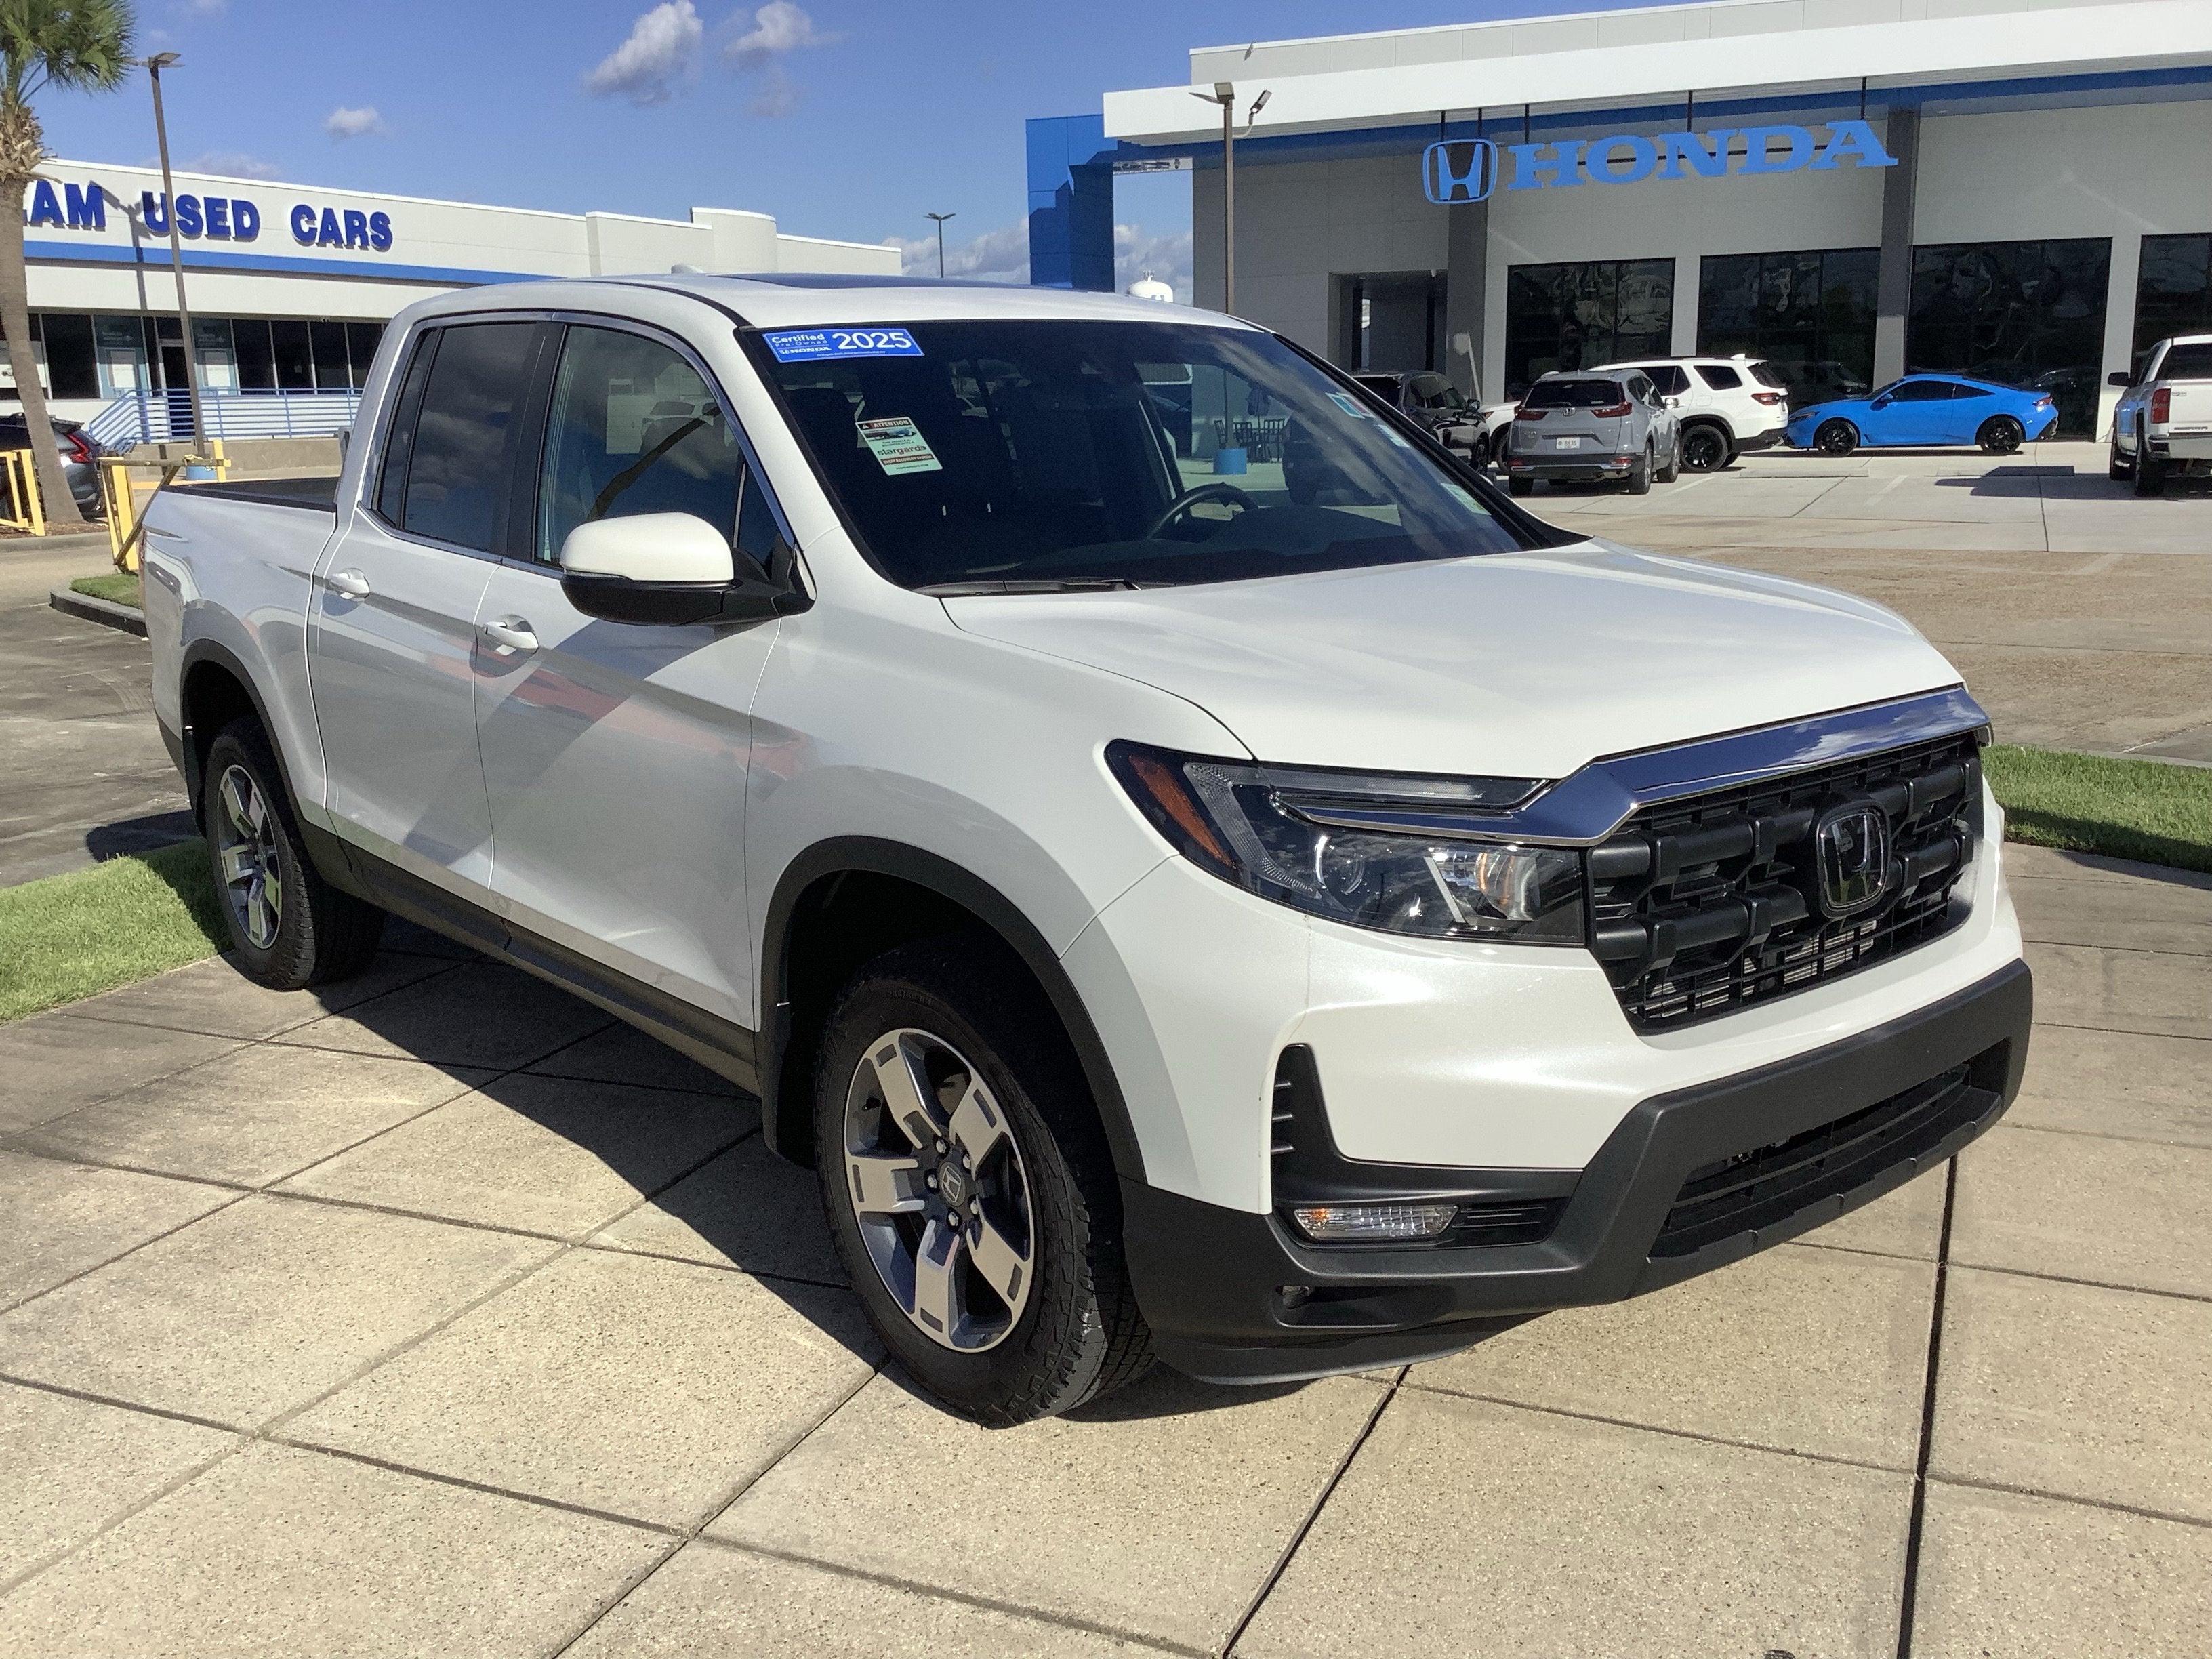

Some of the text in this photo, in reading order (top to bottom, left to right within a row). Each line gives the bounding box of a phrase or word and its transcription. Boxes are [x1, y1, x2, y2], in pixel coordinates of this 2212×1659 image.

[1507, 120, 1899, 192] HONDA
[23, 179, 393, 249] AM USED CARS
[771, 333, 825, 344] Certified
[832, 332, 912, 350] 2025
[874, 419, 909, 428] ATTENTION
